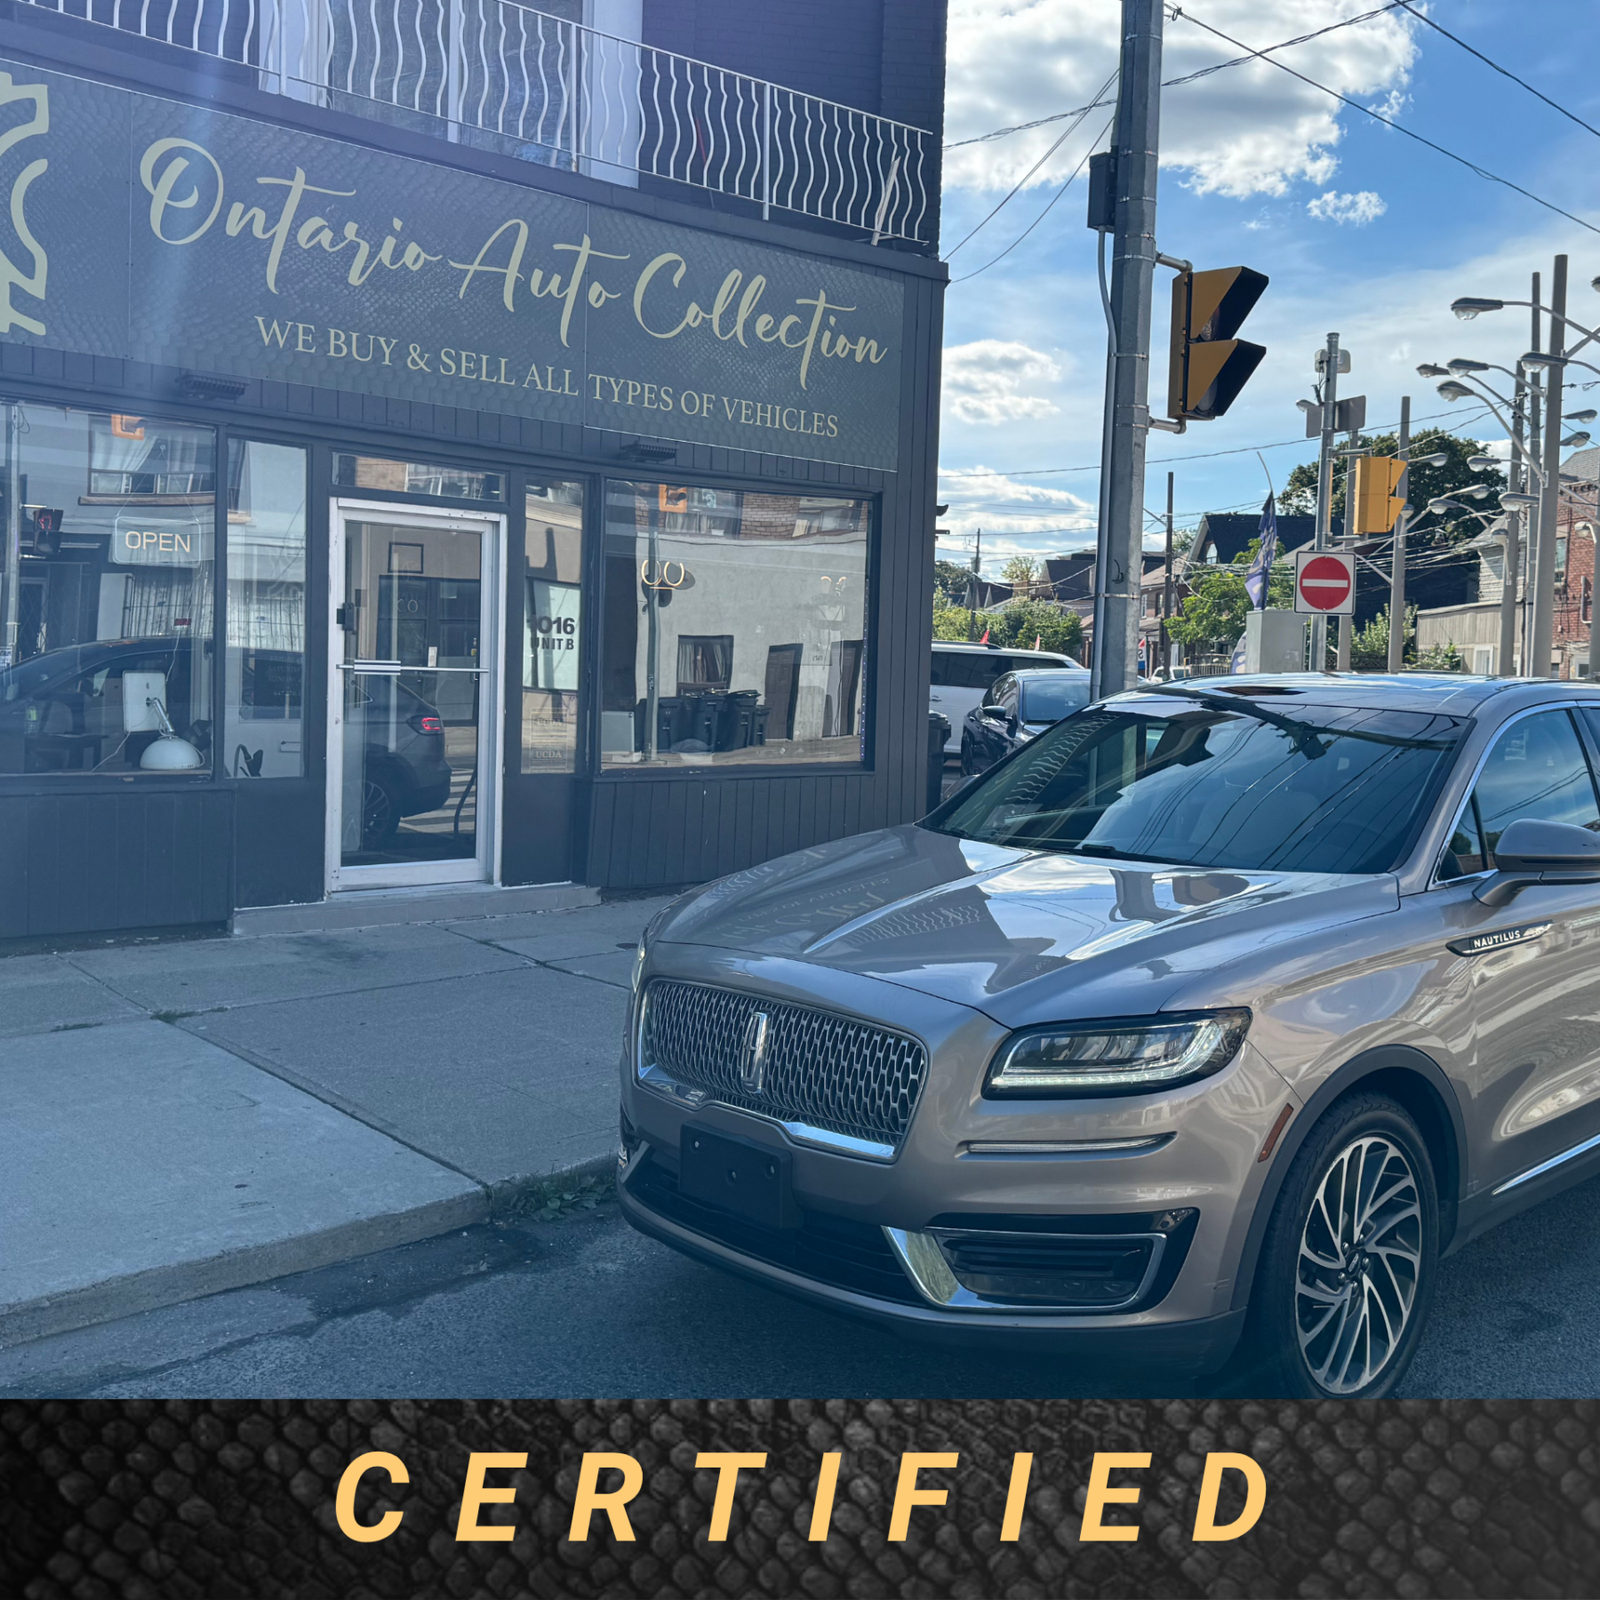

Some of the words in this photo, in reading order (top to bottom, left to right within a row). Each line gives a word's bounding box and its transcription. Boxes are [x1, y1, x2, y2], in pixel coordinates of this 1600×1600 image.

[140, 137, 443, 294] Ontario
[447, 218, 631, 348] Auto
[633, 252, 888, 390] Collection
[254, 315, 317, 353] WE
[327, 328, 398, 366] BUY
[407, 343, 432, 372] &
[439, 348, 515, 386] SELL
[522, 363, 579, 396] ALL
[588, 373, 673, 411] TYPES
[680, 390, 715, 417] OF
[722, 397, 838, 438] VEHICLES
[125, 531, 191, 553] OPEN
[530, 637, 564, 650] UNIT
[566, 638, 574, 650] B
[536, 750, 562, 759] UCDA
[1474, 930, 1521, 948] NAUTILUS
